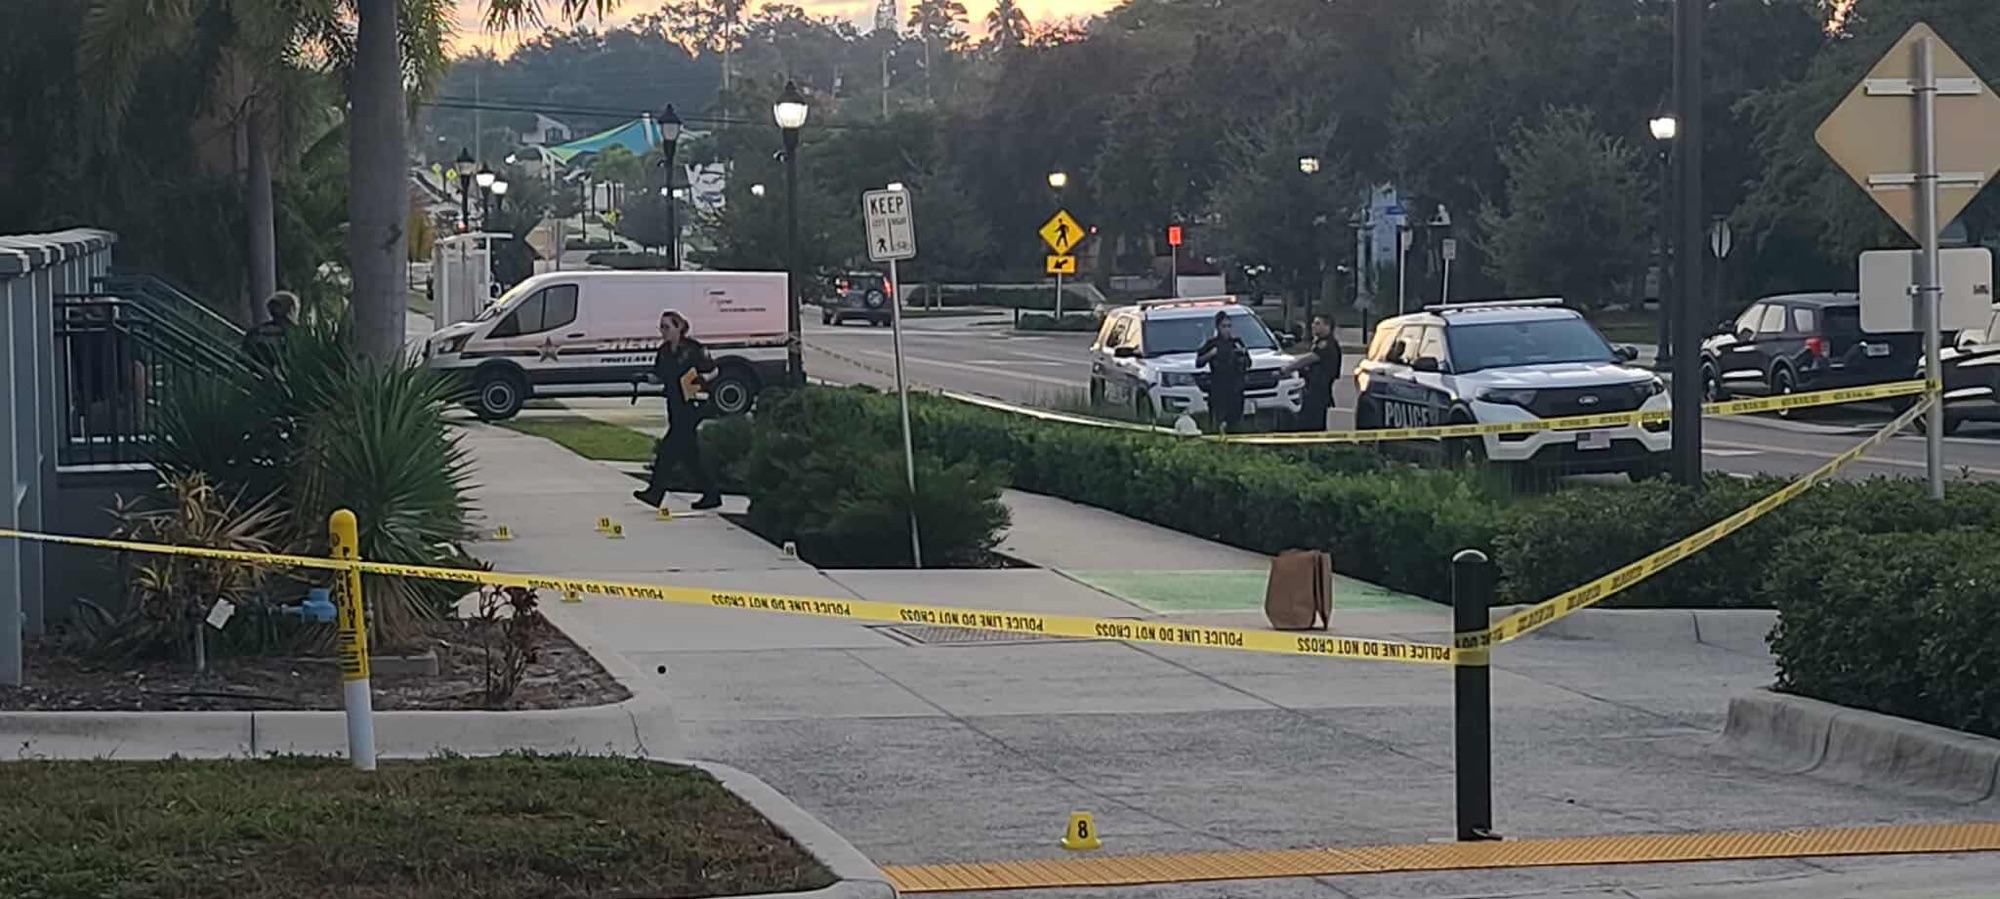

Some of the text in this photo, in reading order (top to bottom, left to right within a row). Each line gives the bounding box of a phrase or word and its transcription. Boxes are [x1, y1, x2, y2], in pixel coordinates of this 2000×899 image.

[869, 196, 904, 215] KEEP
[1384, 401, 1428, 428] POLICE
[711, 594, 851, 616] POLICE LINE DO NOT CROSS
[900, 608, 1044, 631] POLICE LINE DO NOT CROSS
[1095, 623, 1243, 646] POLICE LINE DO NOT CROSS
[1297, 637, 1451, 660] POLICE LINE DO NOT CROSS
[1077, 819, 1088, 839] 8
